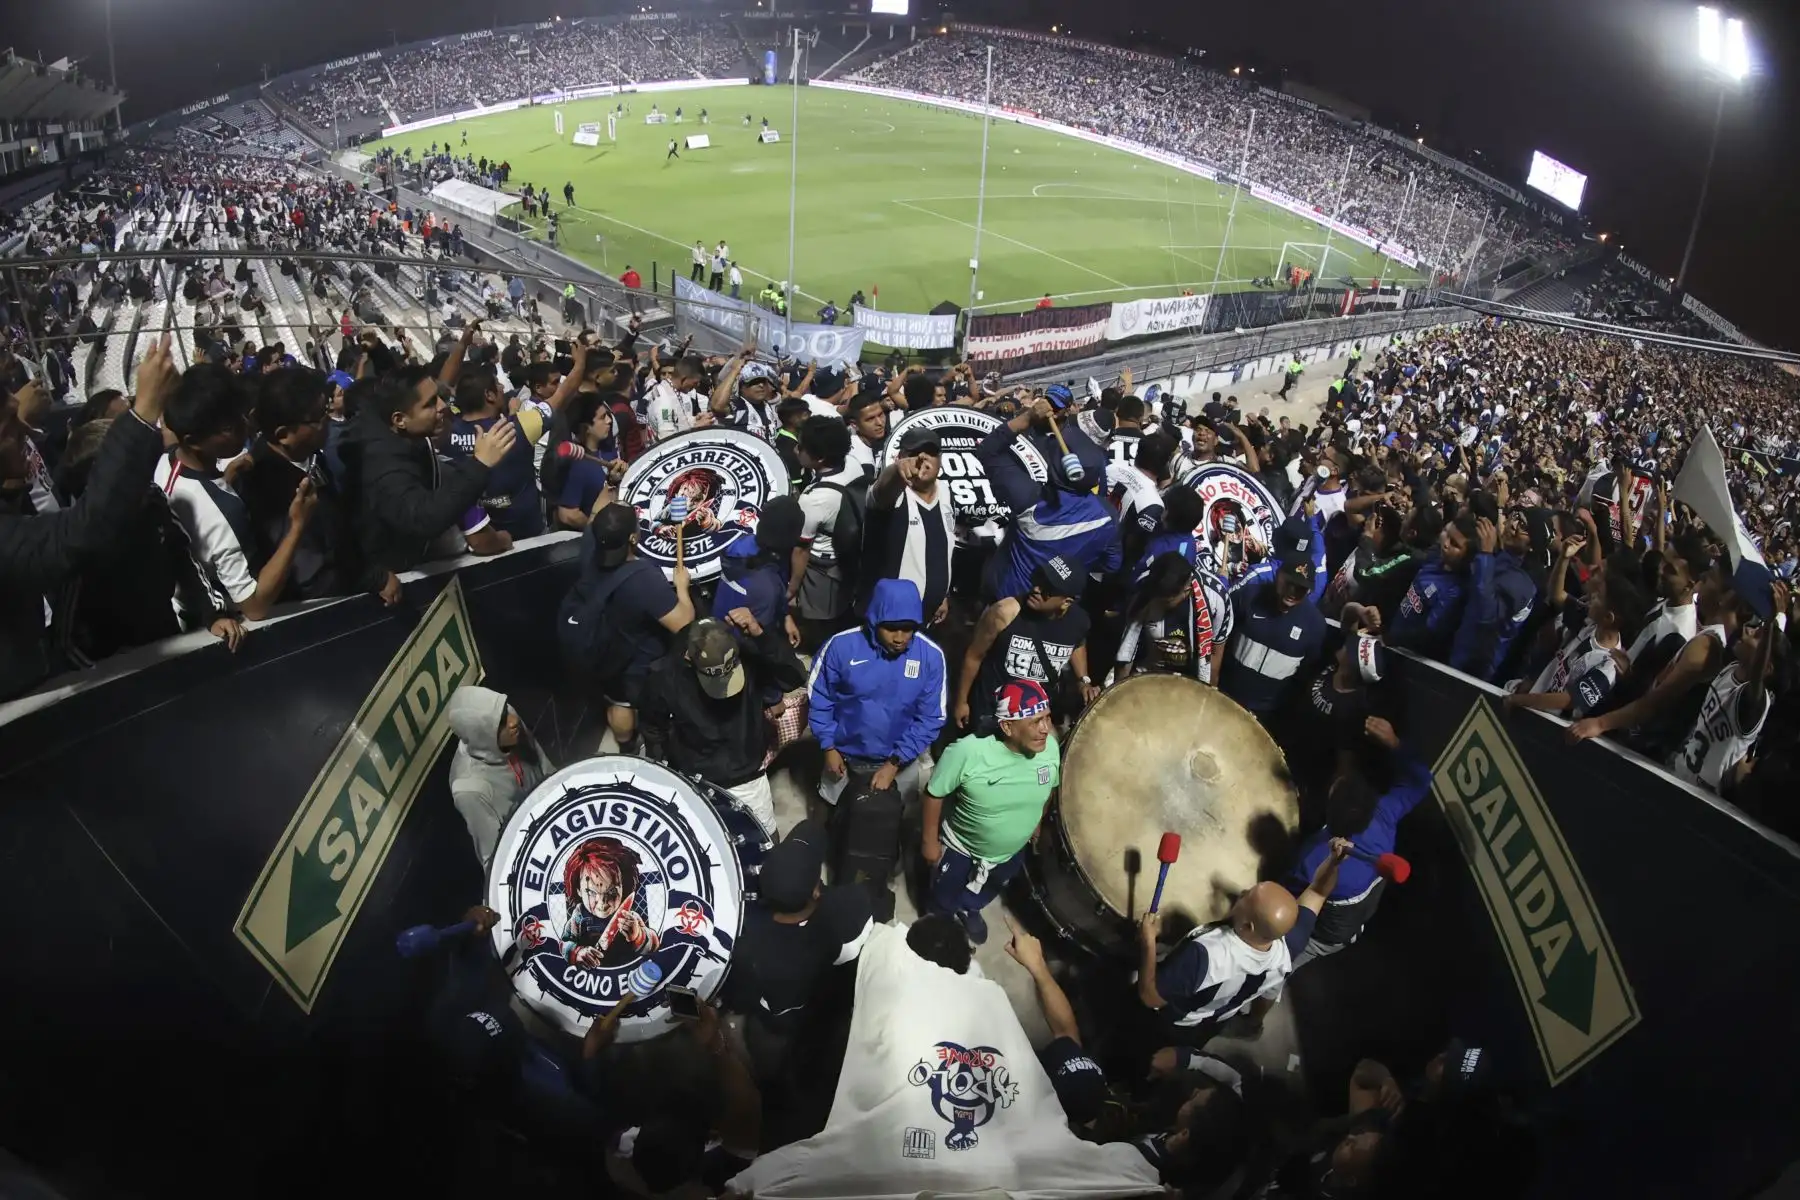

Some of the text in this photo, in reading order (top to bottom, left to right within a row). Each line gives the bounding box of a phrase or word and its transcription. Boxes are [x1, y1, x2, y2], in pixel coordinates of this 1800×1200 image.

[630, 13, 659, 21] ALIANZA
[460, 21, 553, 41] ALIANZA LIMA
[325, 48, 382, 71] ALIANZA LIMA
[181, 93, 230, 116] ALIANZA LIMA
[1617, 252, 1672, 294] ALIANZA LIMA
[935, 414, 950, 424] DE
[637, 451, 757, 499] LA CARRETERA
[1220, 481, 1257, 508] ESTE
[318, 636, 464, 882] SALIDA
[524, 801, 690, 893] EL AGVSTINO
[1456, 746, 1573, 979] SALIDA
[563, 965, 612, 996] CONO
[935, 1046, 996, 1069] GRONE
